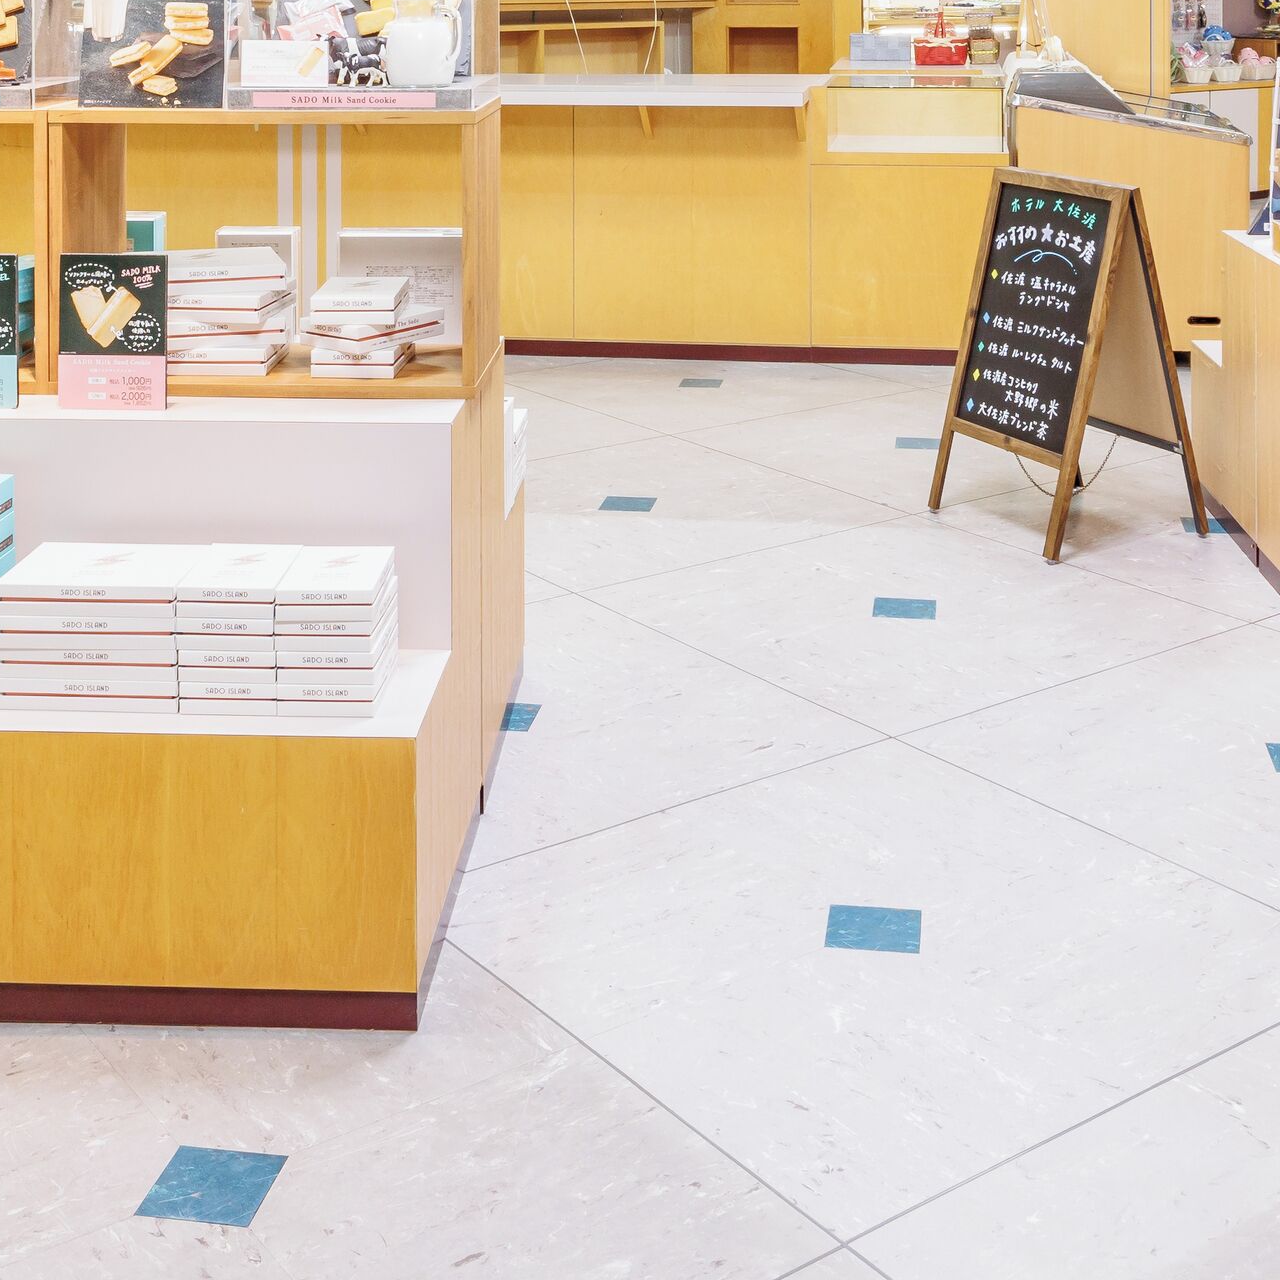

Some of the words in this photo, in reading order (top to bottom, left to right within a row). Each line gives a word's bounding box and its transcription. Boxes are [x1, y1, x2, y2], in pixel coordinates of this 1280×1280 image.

[291, 95, 318, 104] SADO
[322, 95, 343, 104] Milk
[346, 95, 367, 104] Sand
[369, 95, 397, 104] Cookie
[1011, 198, 1044, 212] ホテル
[1053, 198, 1097, 230] 大佐渡
[995, 224, 1037, 250] おすすめ
[1054, 231, 1096, 265] お土産
[121, 268, 140, 277] SADO
[142, 265, 161, 274] MILK
[133, 275, 152, 283] 100%
[1001, 271, 1025, 287] 佐渡
[1030, 276, 1076, 295] 塩キャラメル
[1019, 291, 1070, 312] ラングドシャ
[188, 324, 206, 332] SADO
[208, 324, 228, 332] ISLAND
[992, 315, 1013, 331] 佐渡
[1017, 316, 1084, 347] ミルクサンドクッキー
[988, 342, 1008, 358] 佐渡
[1051, 358, 1072, 374] タルト
[122, 377, 152, 386] 1,000円
[982, 370, 1038, 393] 佐渡産コシヒカリ
[121, 392, 152, 401] 2,000円
[1005, 390, 1059, 420] 大野郷の米
[977, 402, 1050, 440] 大佐渡ブレンド茶
